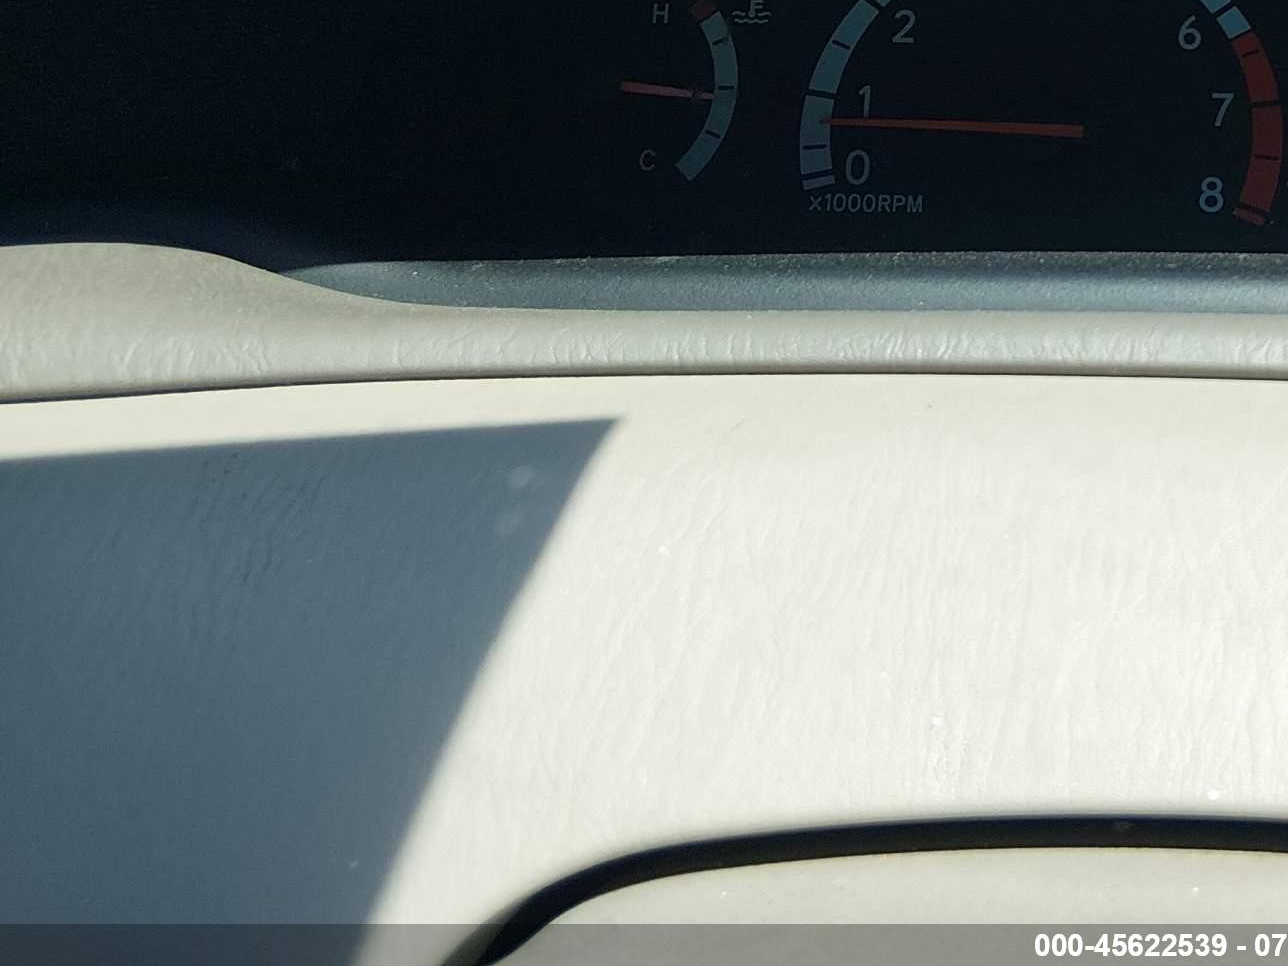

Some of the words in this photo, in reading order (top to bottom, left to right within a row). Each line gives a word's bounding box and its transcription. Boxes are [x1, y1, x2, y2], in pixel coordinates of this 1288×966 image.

[652, 4, 669, 23] H
[893, 10, 915, 43] 2
[1179, 16, 1201, 50] 6
[859, 86, 871, 116] 1
[1212, 93, 1234, 126] 7
[640, 150, 656, 170] C
[846, 150, 870, 185] 0
[1199, 177, 1223, 212] 8
